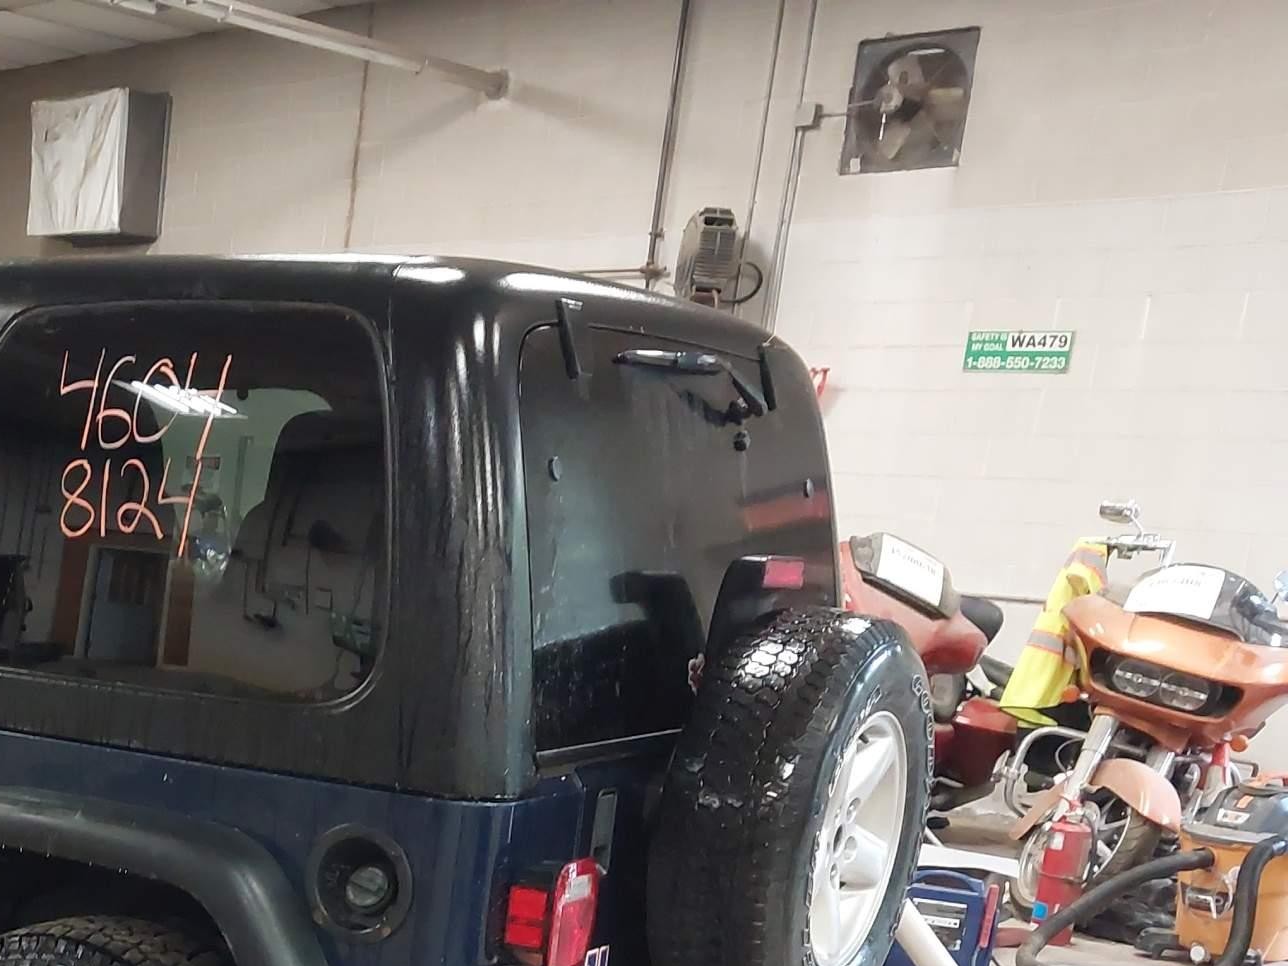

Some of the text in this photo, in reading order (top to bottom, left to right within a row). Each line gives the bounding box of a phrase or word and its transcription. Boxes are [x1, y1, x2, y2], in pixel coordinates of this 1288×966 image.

[966, 356, 1067, 369] 1-888-550-7233
[1011, 334, 1068, 349] WA479
[59, 347, 233, 460] 4604
[60, 457, 203, 559] 8124
